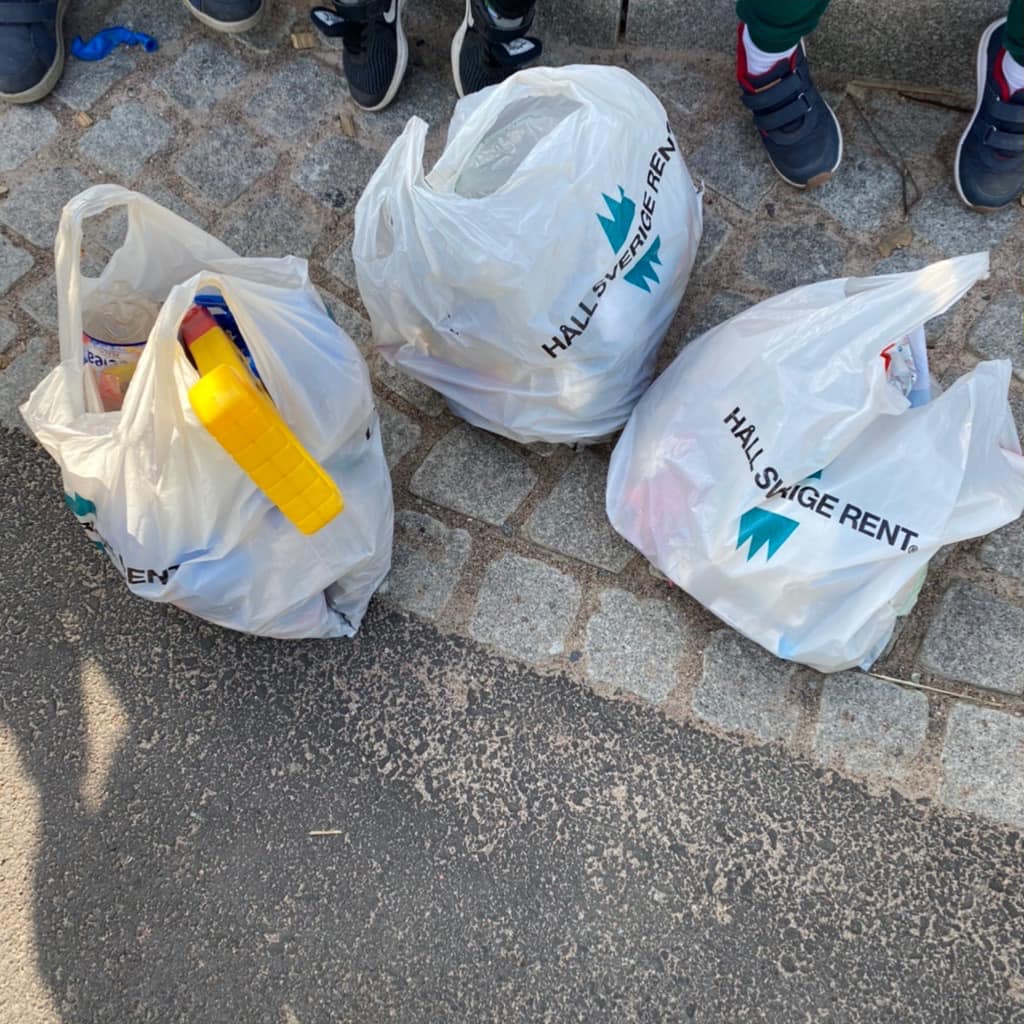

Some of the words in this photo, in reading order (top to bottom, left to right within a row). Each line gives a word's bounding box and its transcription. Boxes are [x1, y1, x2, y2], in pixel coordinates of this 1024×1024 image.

[541, 301, 598, 358] HÅLL
[592, 191, 656, 298] SVERIGE
[723, 406, 764, 472] HÅLL
